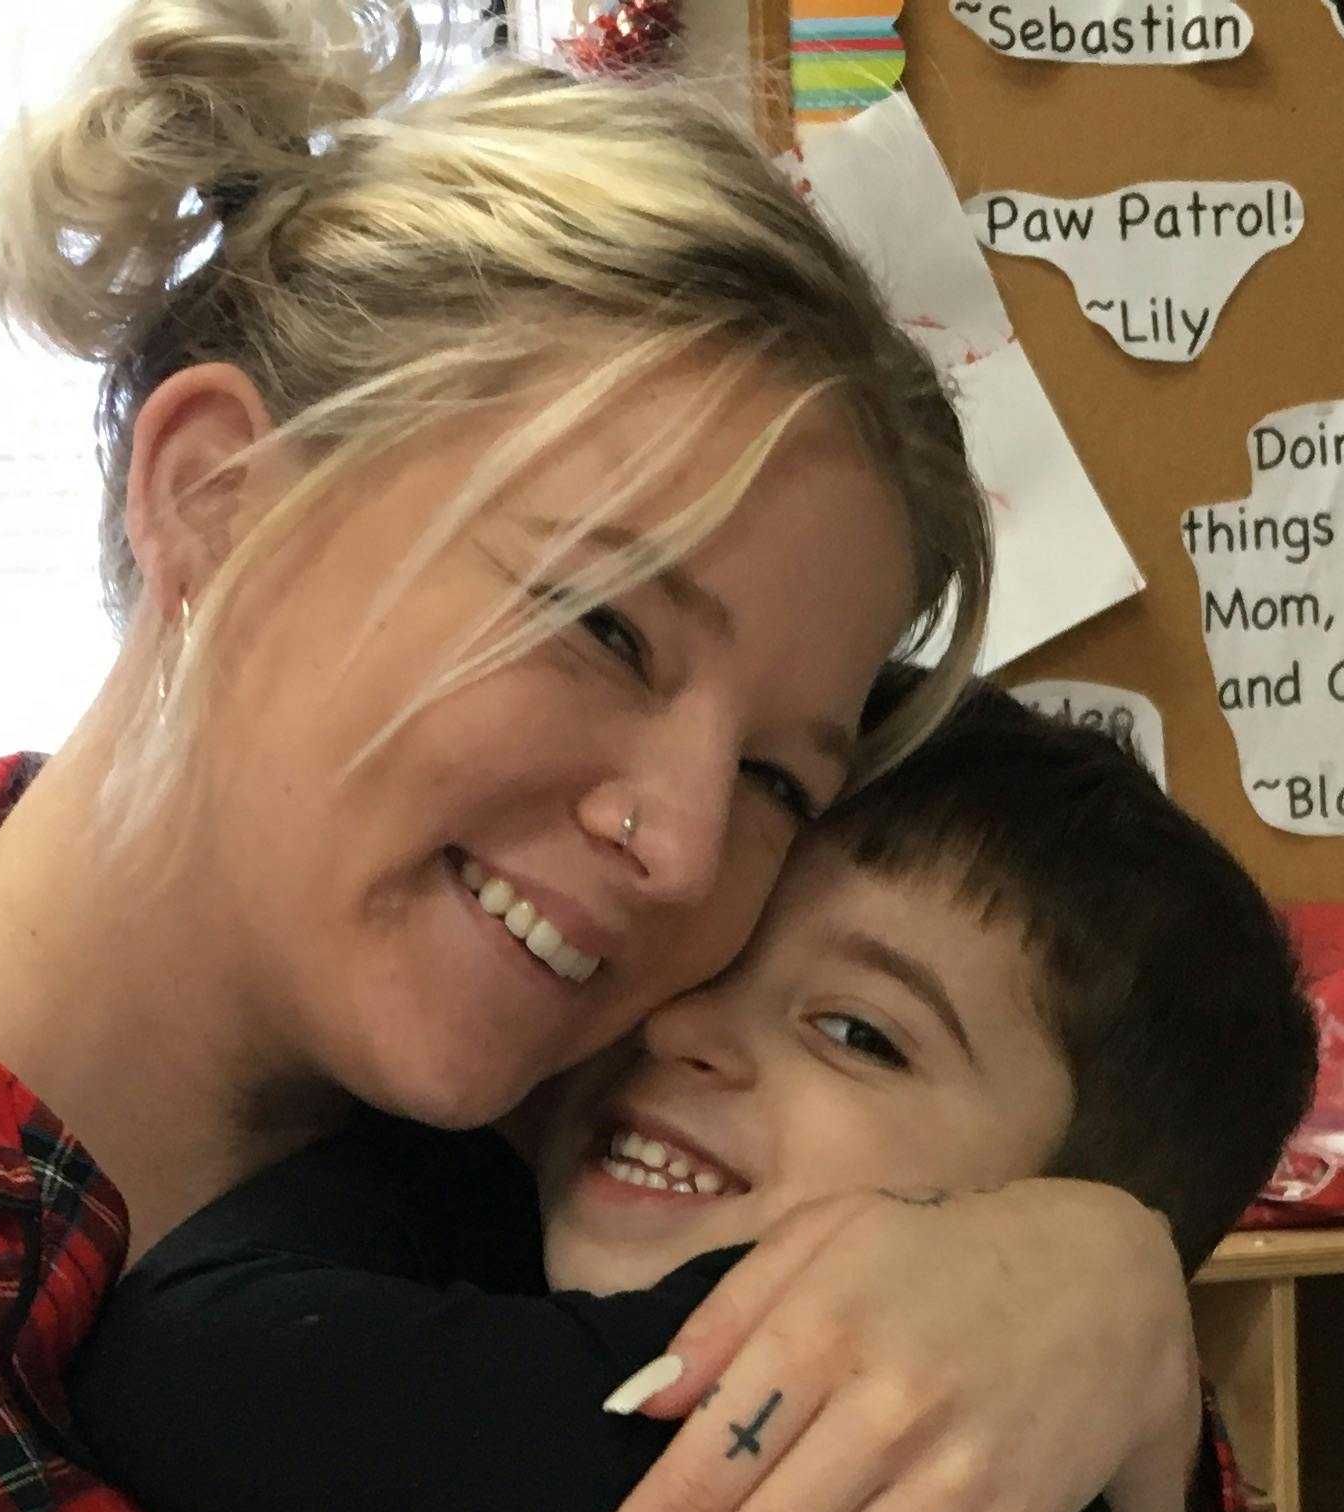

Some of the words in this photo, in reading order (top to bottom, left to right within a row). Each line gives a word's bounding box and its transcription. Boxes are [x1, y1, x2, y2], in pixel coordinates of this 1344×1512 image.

[986, 196, 1094, 244] Paw
[1118, 189, 1295, 241] Patrol!
[1086, 297, 1210, 356] ~Lily
[1182, 507, 1334, 564] things
[1205, 588, 1334, 633] Mom,
[1217, 660, 1301, 711] and
